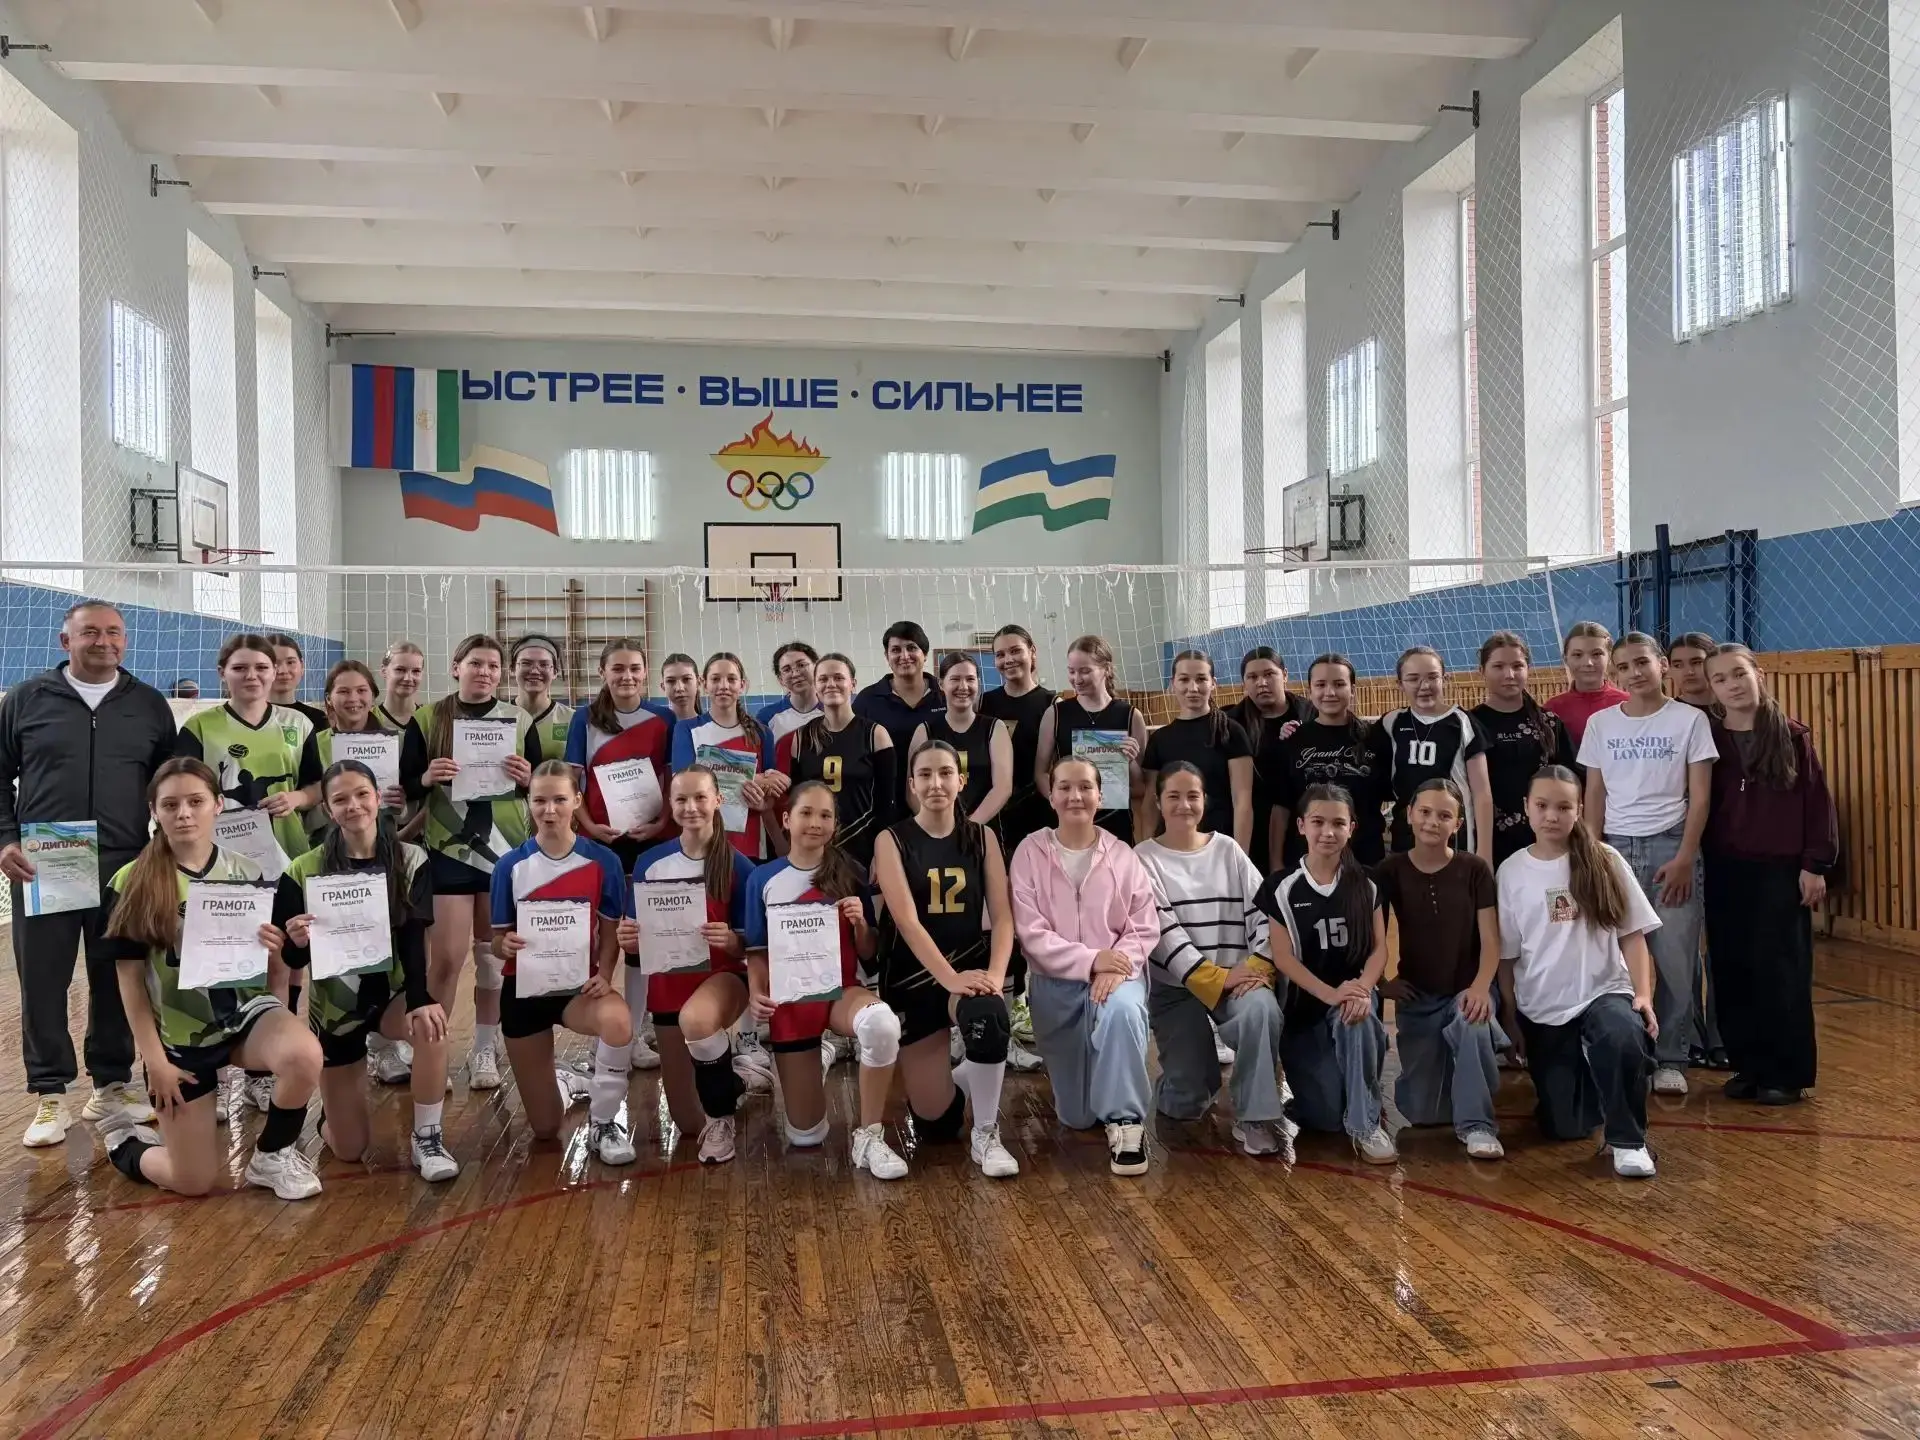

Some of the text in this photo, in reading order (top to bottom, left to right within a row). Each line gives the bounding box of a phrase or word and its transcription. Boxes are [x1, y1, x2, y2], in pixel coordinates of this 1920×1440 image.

[462, 369, 1083, 413] ЫСТРЕЕ ВЫШЕ СИЛЬНЕЕ
[465, 732, 504, 741] ГРАМОТА
[1607, 736, 1673, 749] SEASIDE
[347, 746, 387, 755] ГРАМОТА
[1296, 745, 1345, 769] Grand
[1408, 740, 1437, 766] 10
[607, 768, 644, 781] ГРАМОТА
[823, 755, 843, 792] 9
[215, 821, 258, 837] ГРАМОТА
[41, 839, 90, 851] ДИПЛОМ
[322, 888, 372, 902] ГРАМОТА
[927, 867, 967, 914] 12
[202, 900, 256, 911] ГРАМОТА
[647, 895, 692, 907] ГРАМОТА
[530, 915, 576, 926] ГРАМОТА
[780, 917, 826, 930] ГРАМОТА
[1313, 917, 1349, 950] 15
